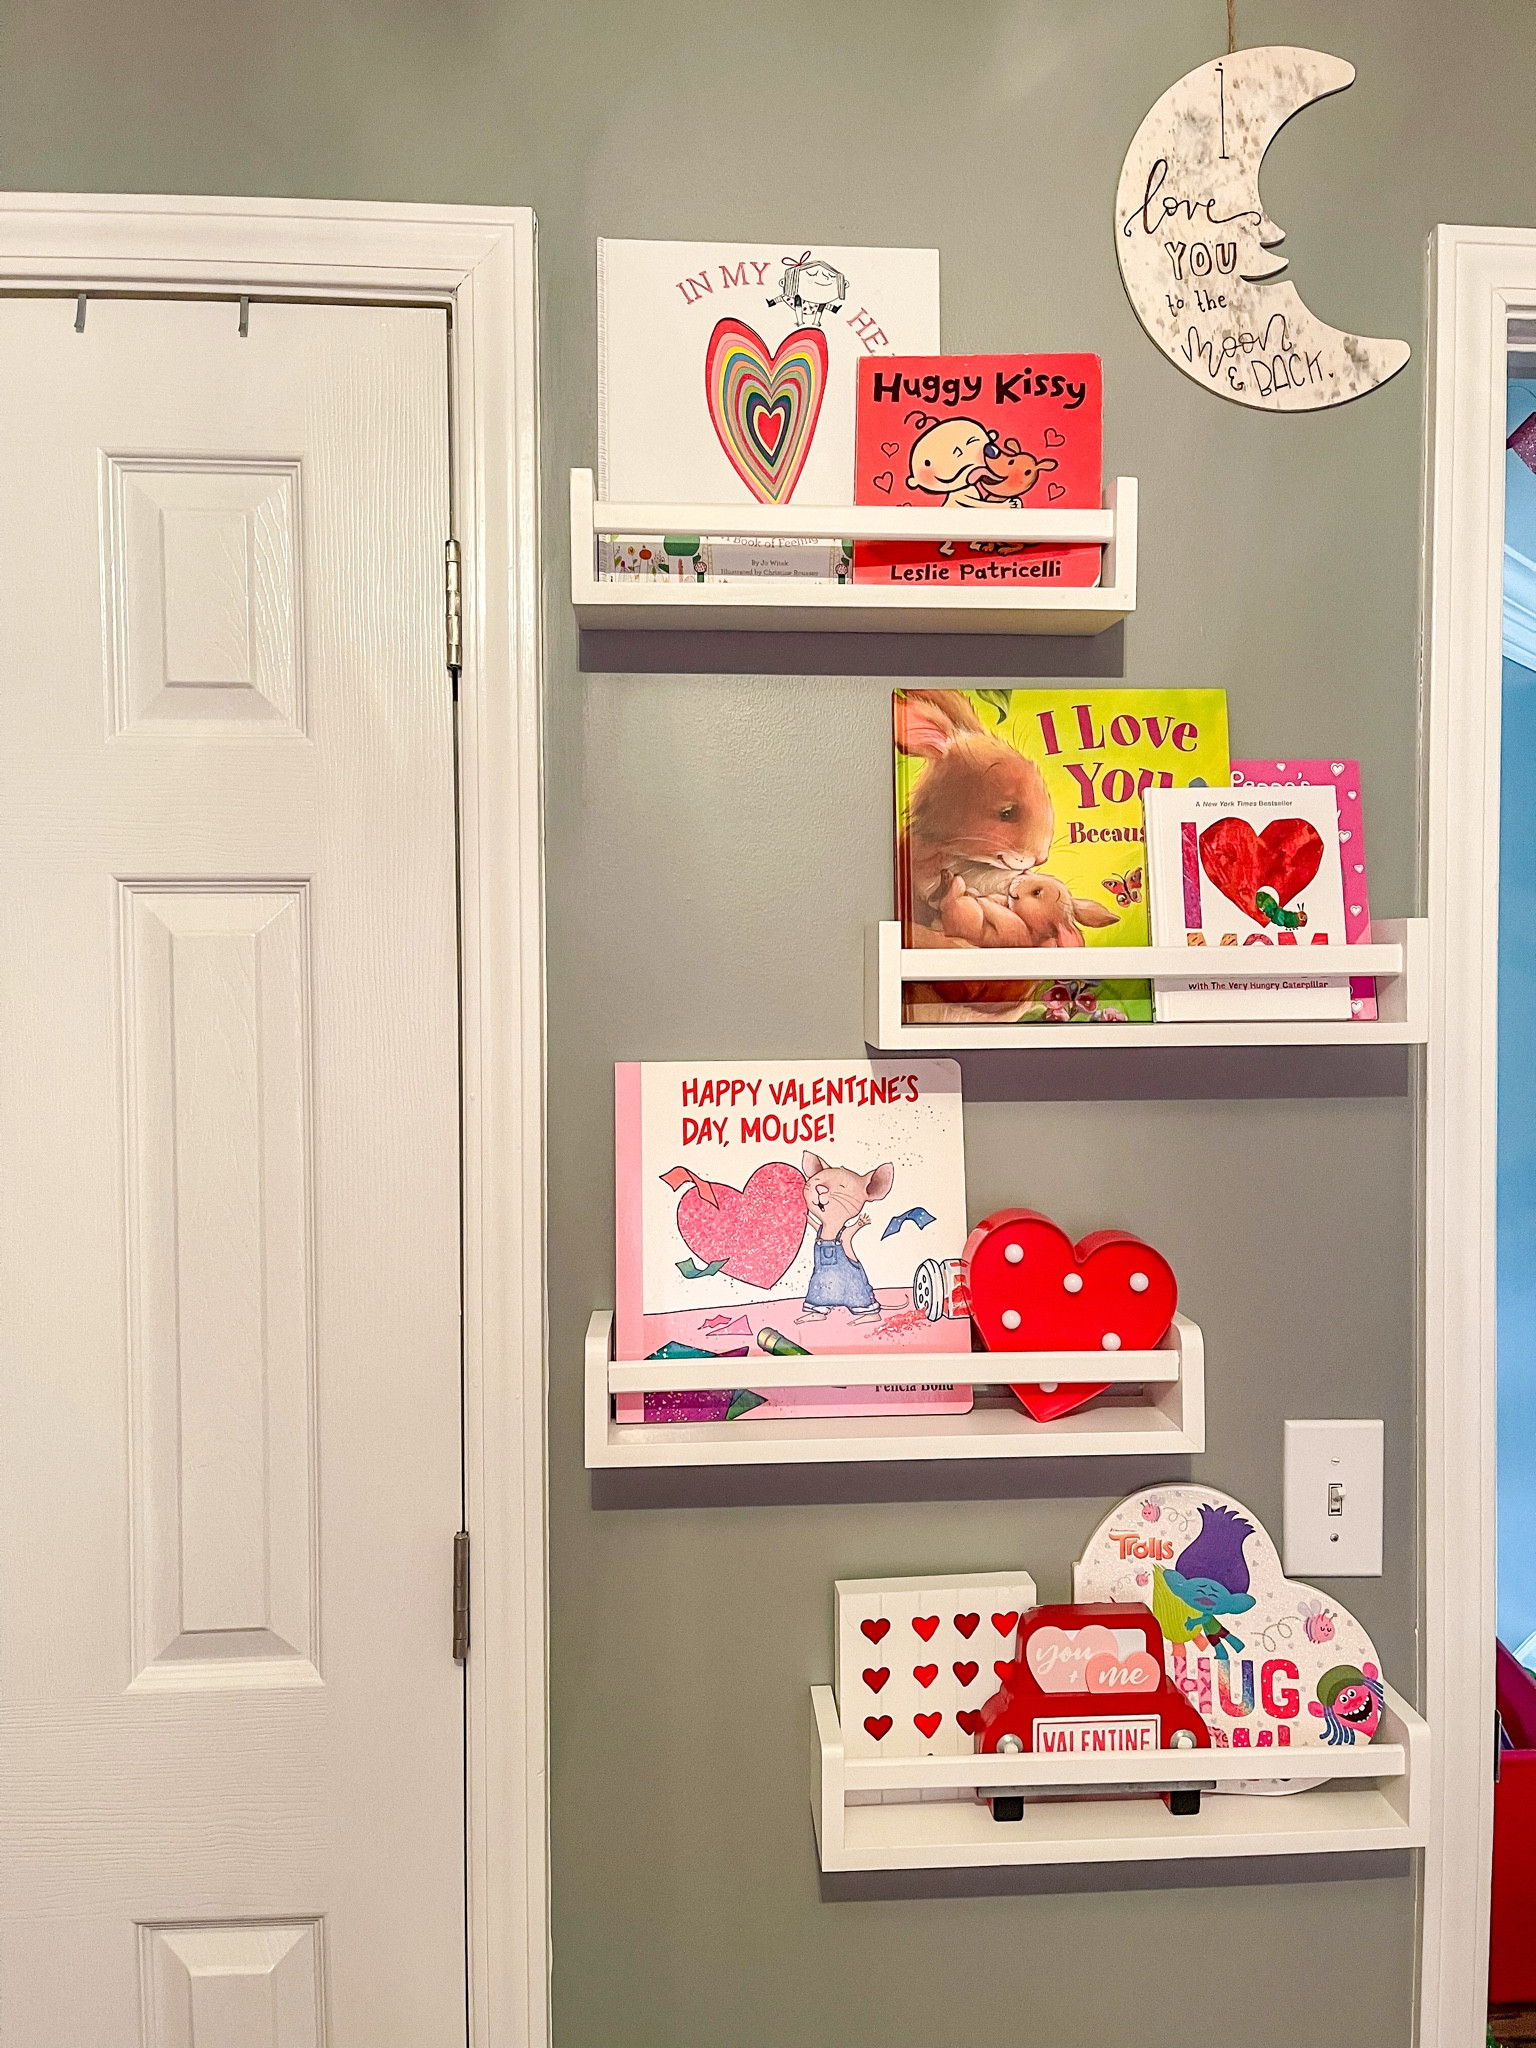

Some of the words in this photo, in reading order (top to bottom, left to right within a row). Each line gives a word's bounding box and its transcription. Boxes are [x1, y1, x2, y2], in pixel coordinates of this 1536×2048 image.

[1123, 158, 1262, 237] love
[1164, 241, 1237, 281] YOU
[675, 270, 715, 306] IN
[718, 261, 771, 290] MY
[845, 307, 896, 356] HE
[1165, 294, 1185, 317] to
[1193, 290, 1228, 313] the
[872, 371, 983, 408] Huggy
[994, 366, 1087, 410] Kissy
[889, 563, 951, 582] Leslie
[959, 560, 1062, 581] Patricelli
[1035, 709, 1063, 757] I
[1071, 703, 1200, 753] Love
[1066, 821, 1147, 846] Becaus
[1188, 981, 1209, 991] with
[1210, 981, 1226, 990] The
[1228, 981, 1248, 991] Very
[1249, 981, 1280, 991] Hungry
[1282, 980, 1329, 990] Caterpillar
[681, 1078, 762, 1108] HAPPY
[769, 1074, 920, 1109] VALENTINE'S
[682, 1116, 730, 1148] DAY,
[740, 1113, 836, 1145] MOUSE!
[1108, 1532, 1175, 1561] Trolls
[1035, 1643, 1096, 1676] you
[1098, 1665, 1151, 1688] me
[1173, 1655, 1301, 1720] HUG
[1042, 1728, 1151, 1752] VALENTINE
